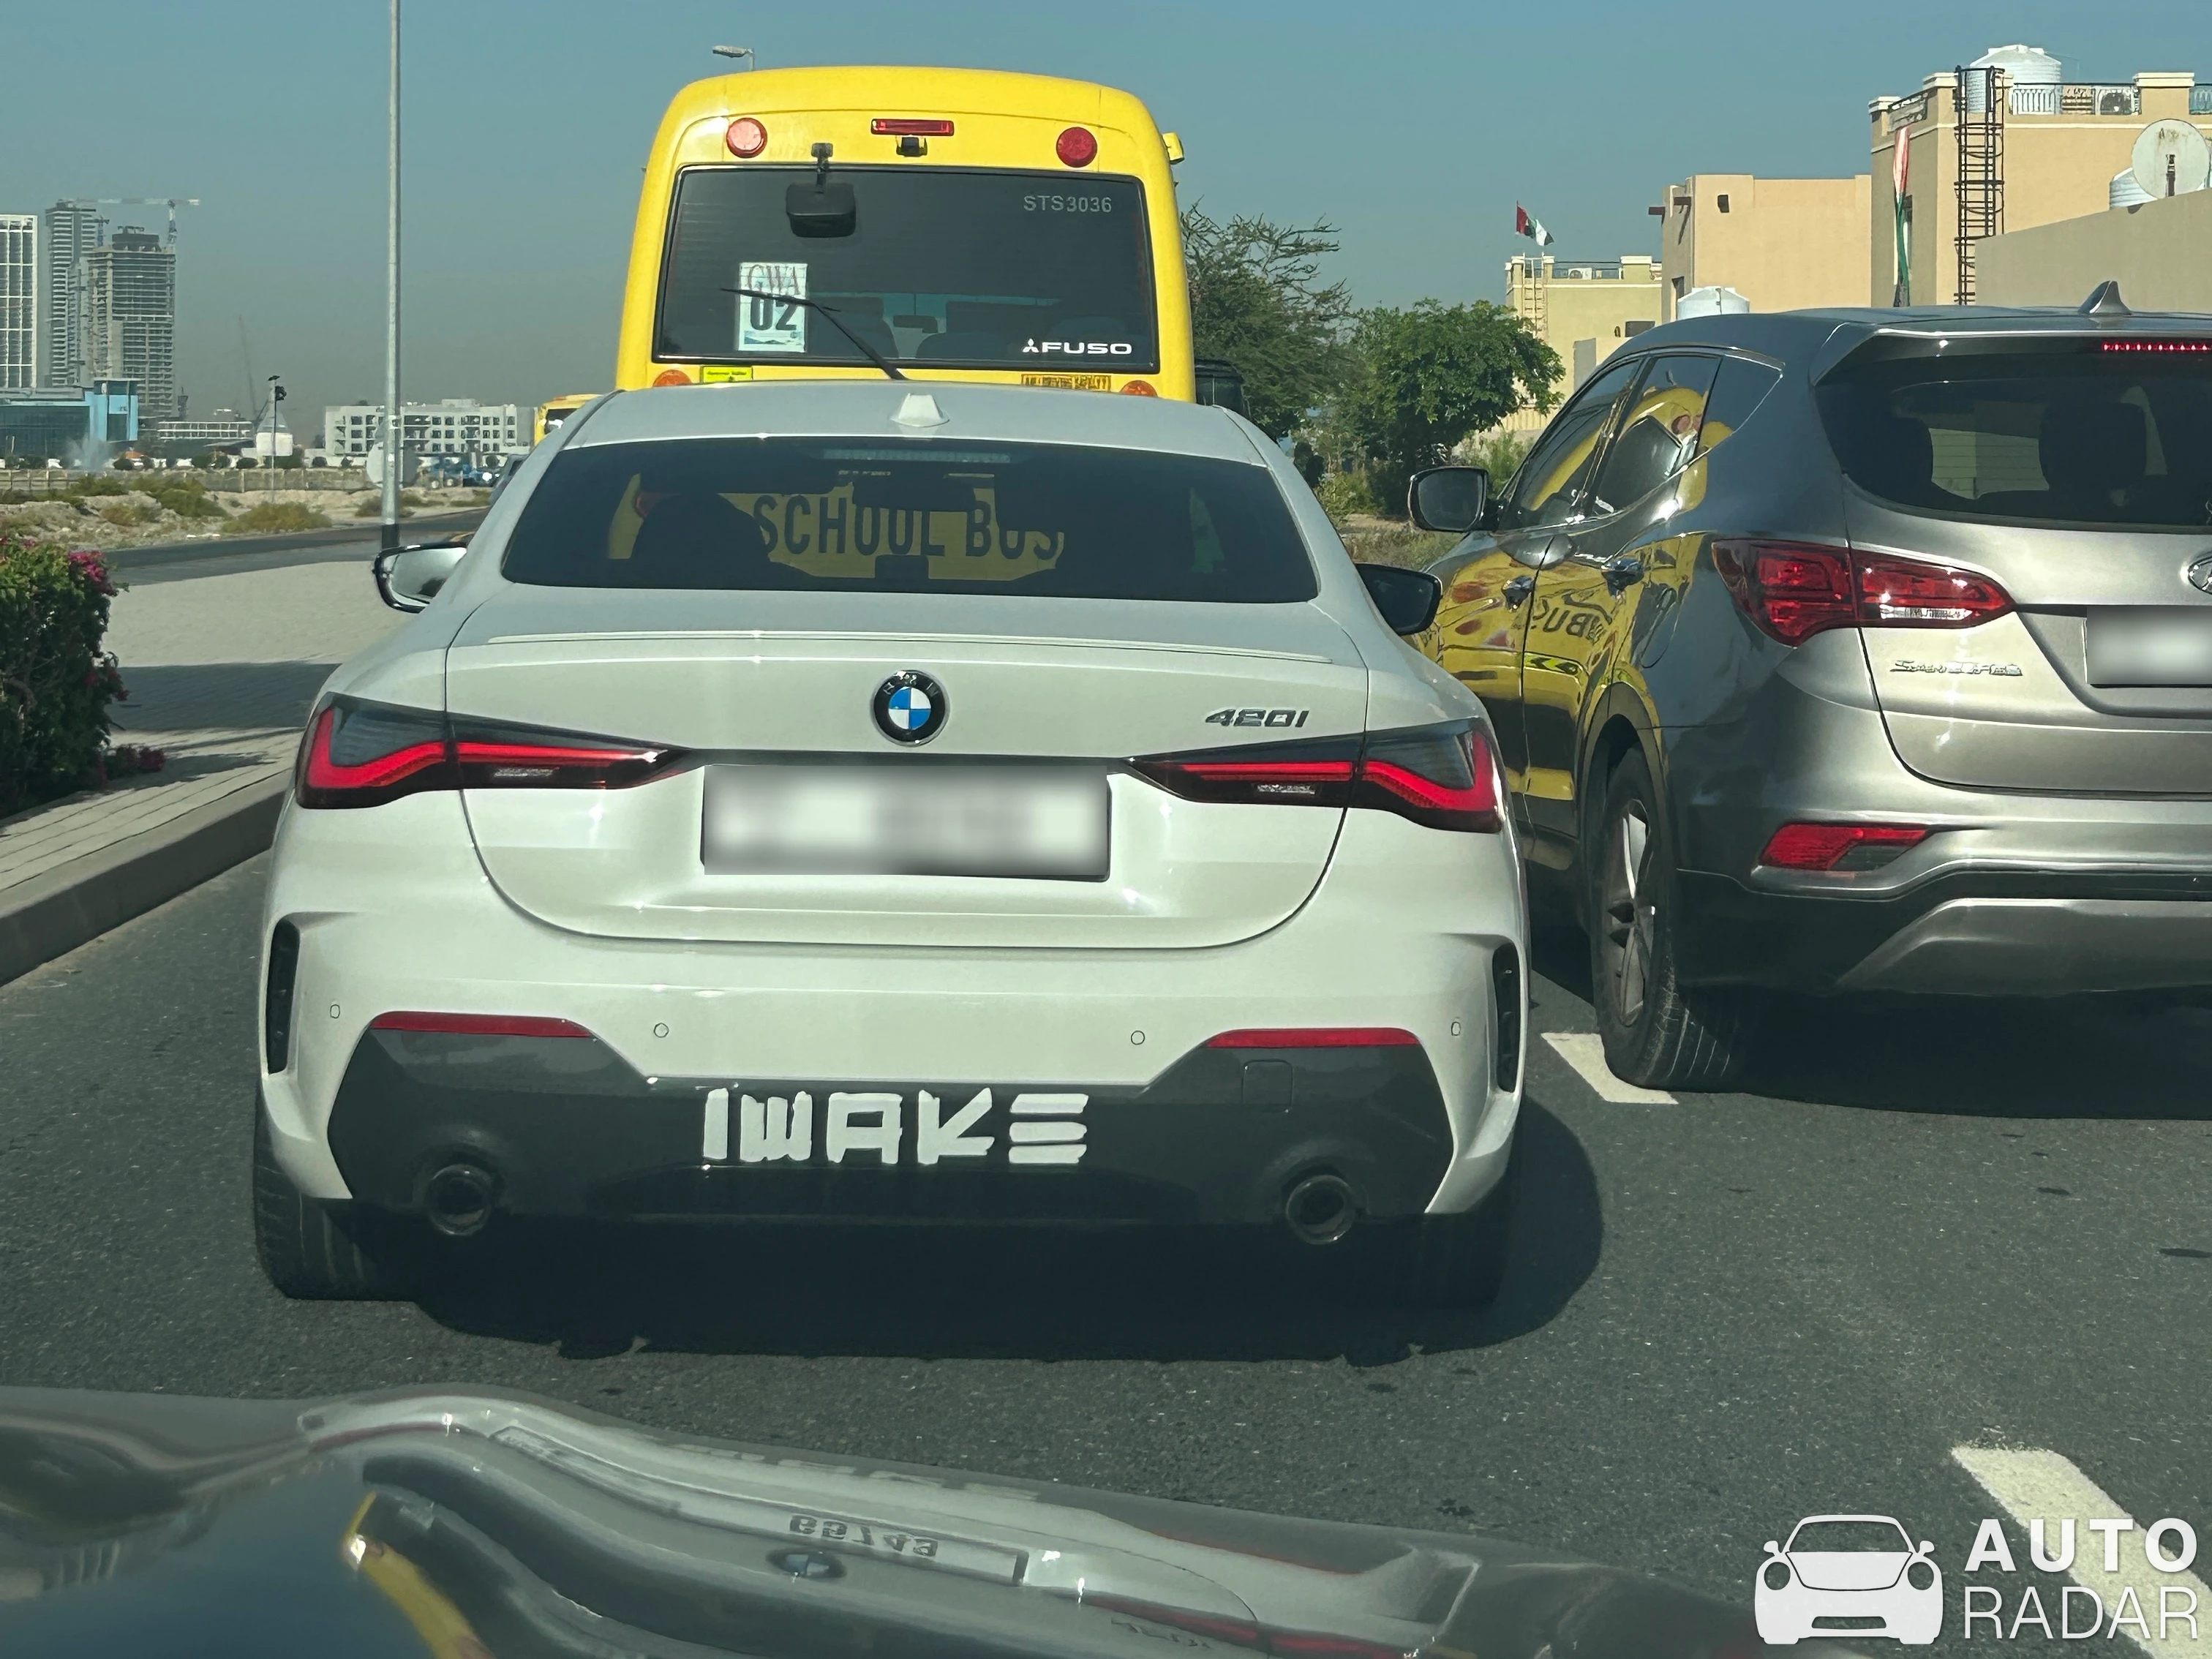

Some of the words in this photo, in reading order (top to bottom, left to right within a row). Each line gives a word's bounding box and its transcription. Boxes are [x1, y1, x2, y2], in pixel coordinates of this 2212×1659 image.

[1023, 195, 1112, 213] STS3036
[750, 294, 797, 331] 02
[1042, 342, 1132, 355] FUSO
[753, 494, 946, 556] SCHOOL
[703, 1087, 1089, 1165] IWAKE
